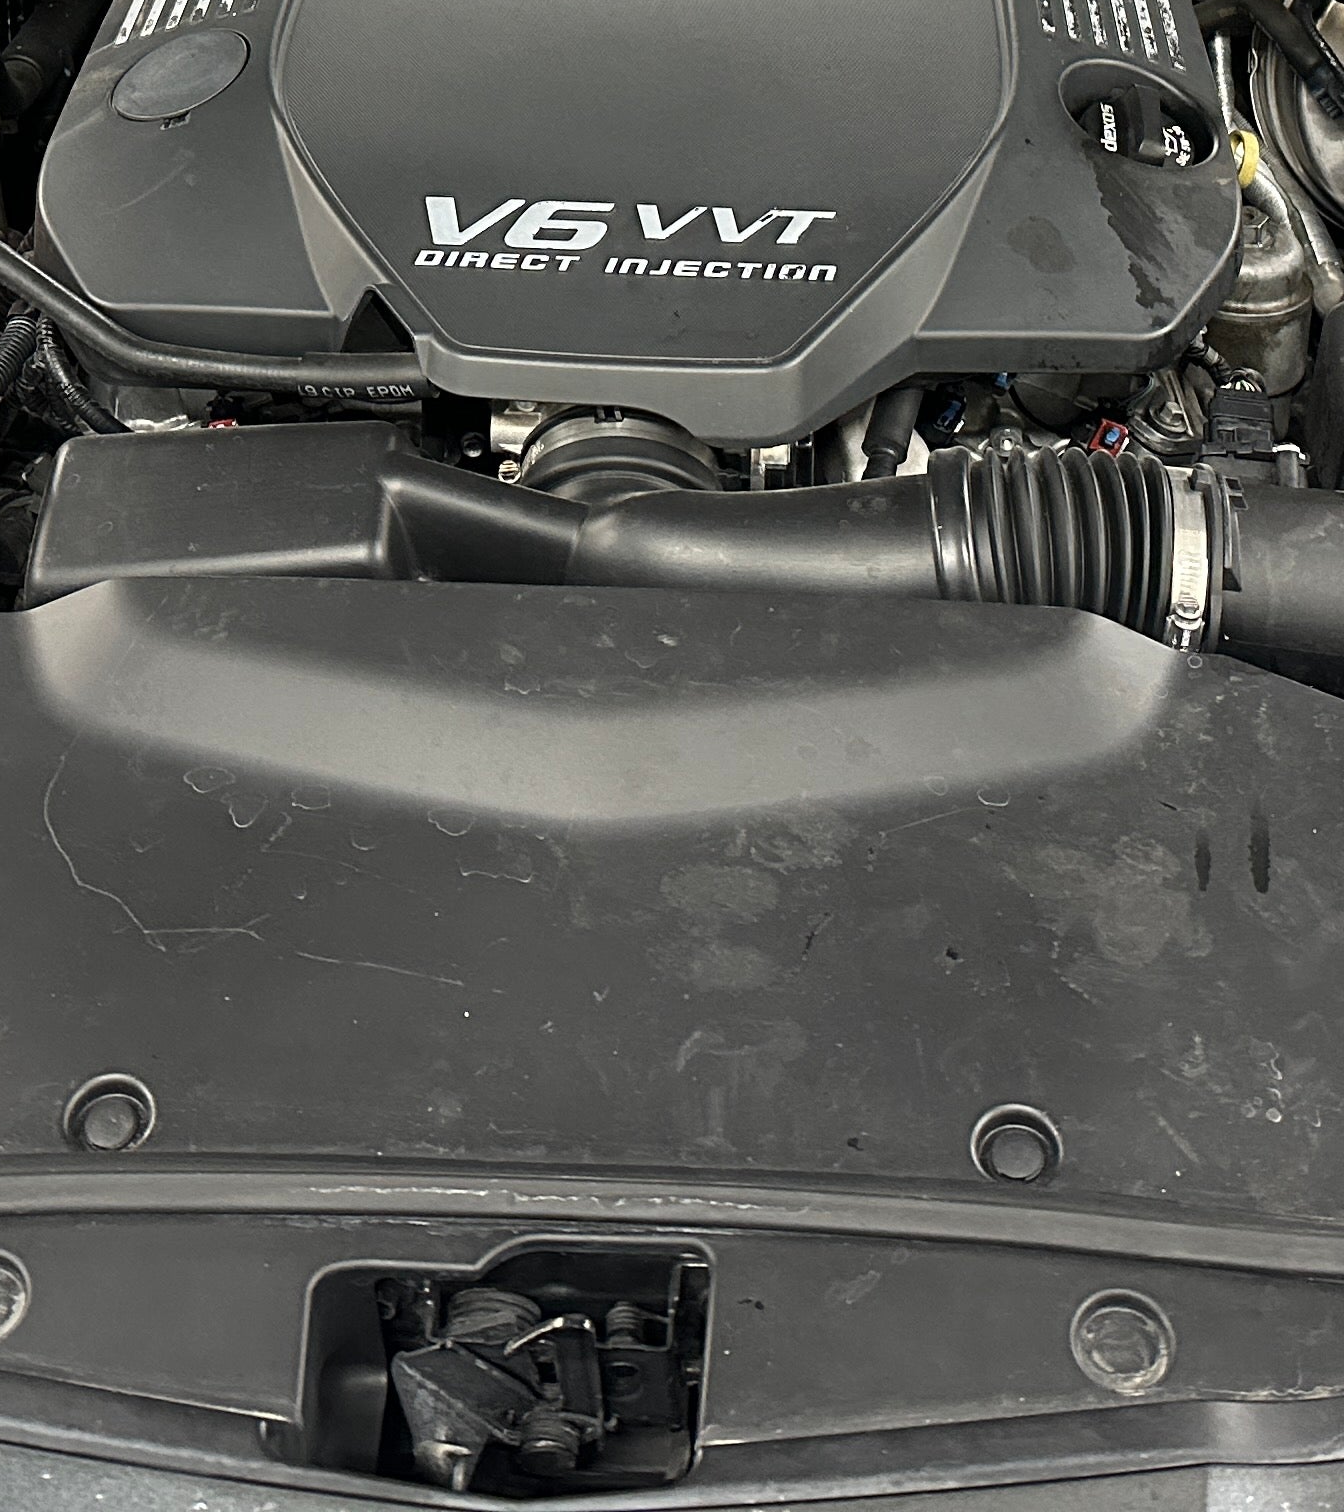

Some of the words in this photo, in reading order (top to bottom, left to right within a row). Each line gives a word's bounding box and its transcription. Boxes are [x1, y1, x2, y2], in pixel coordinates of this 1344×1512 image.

[1099, 99, 1118, 153] dexos
[425, 196, 615, 250] V6
[635, 203, 837, 245] VVT
[414, 249, 581, 272] DIRECT
[604, 256, 837, 282] INJECTION
[366, 384, 415, 398] EPDM
